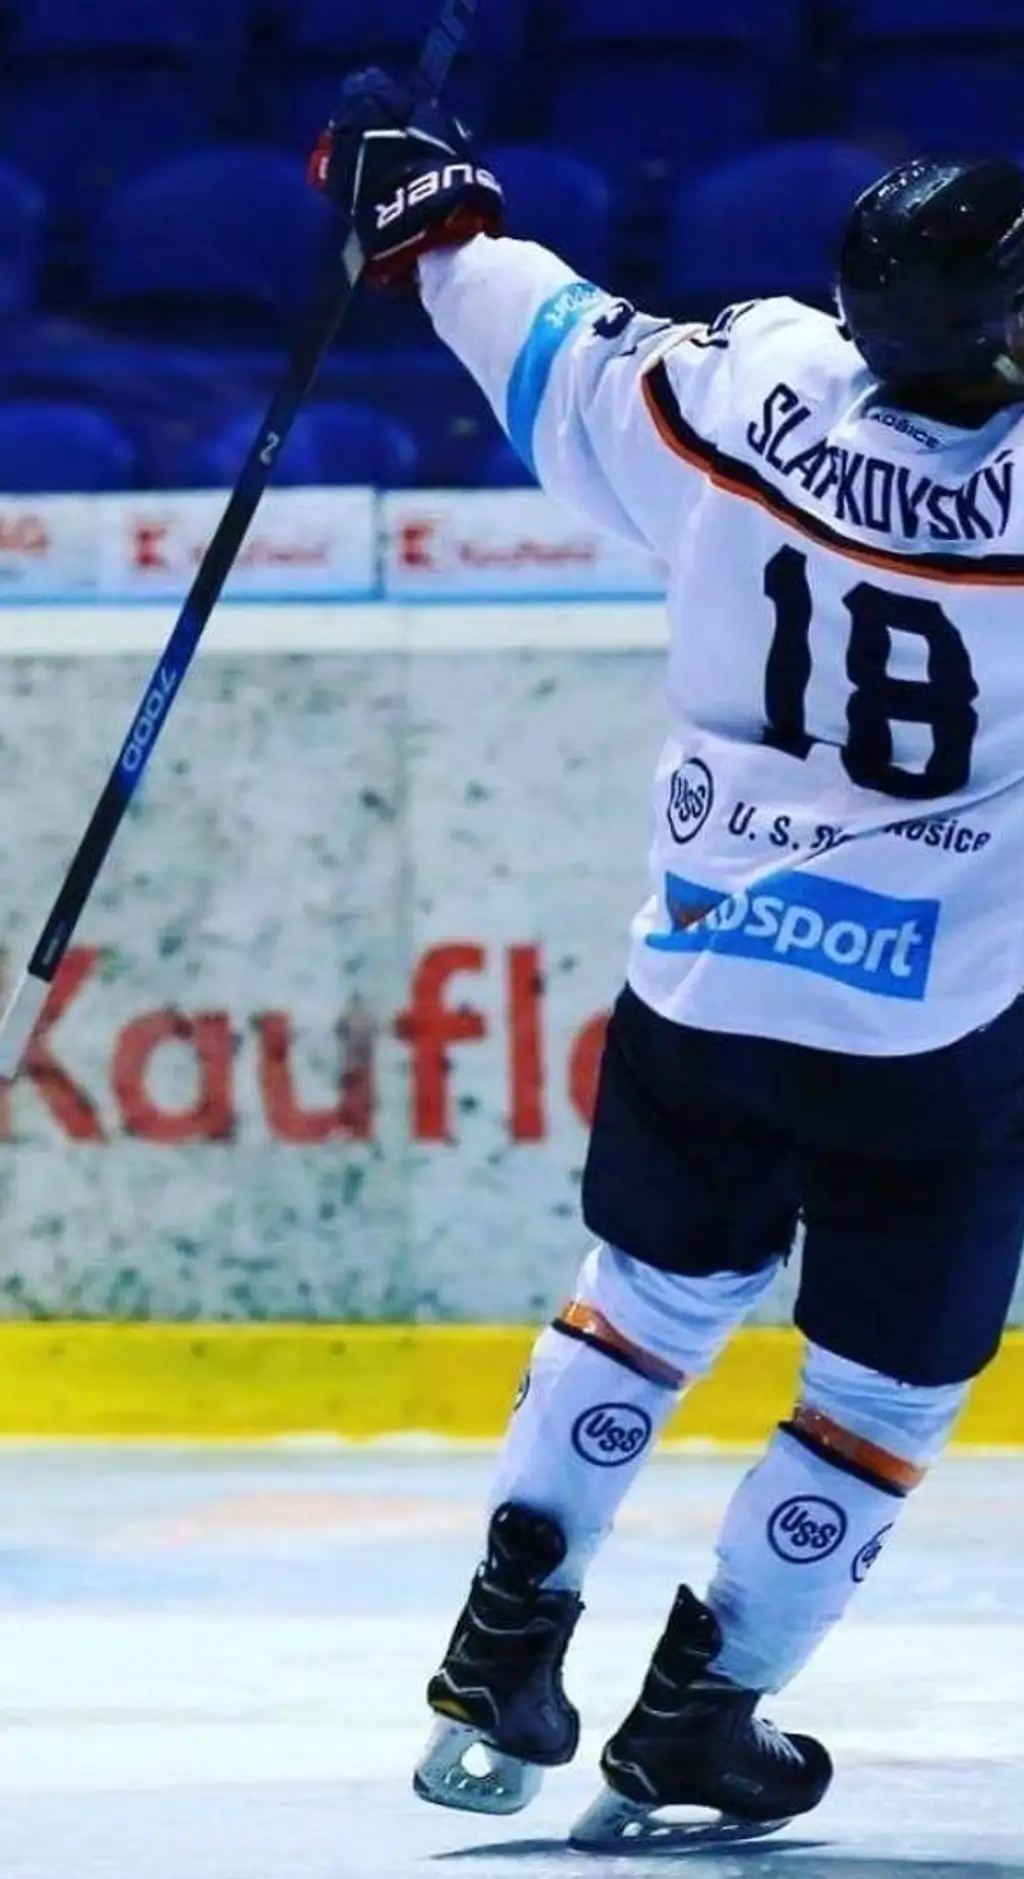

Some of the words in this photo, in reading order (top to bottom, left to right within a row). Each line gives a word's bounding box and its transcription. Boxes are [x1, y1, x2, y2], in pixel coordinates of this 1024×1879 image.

[764, 544, 979, 800] 18
[585, 1411, 645, 1453] USS
[780, 1506, 837, 1549] USS
